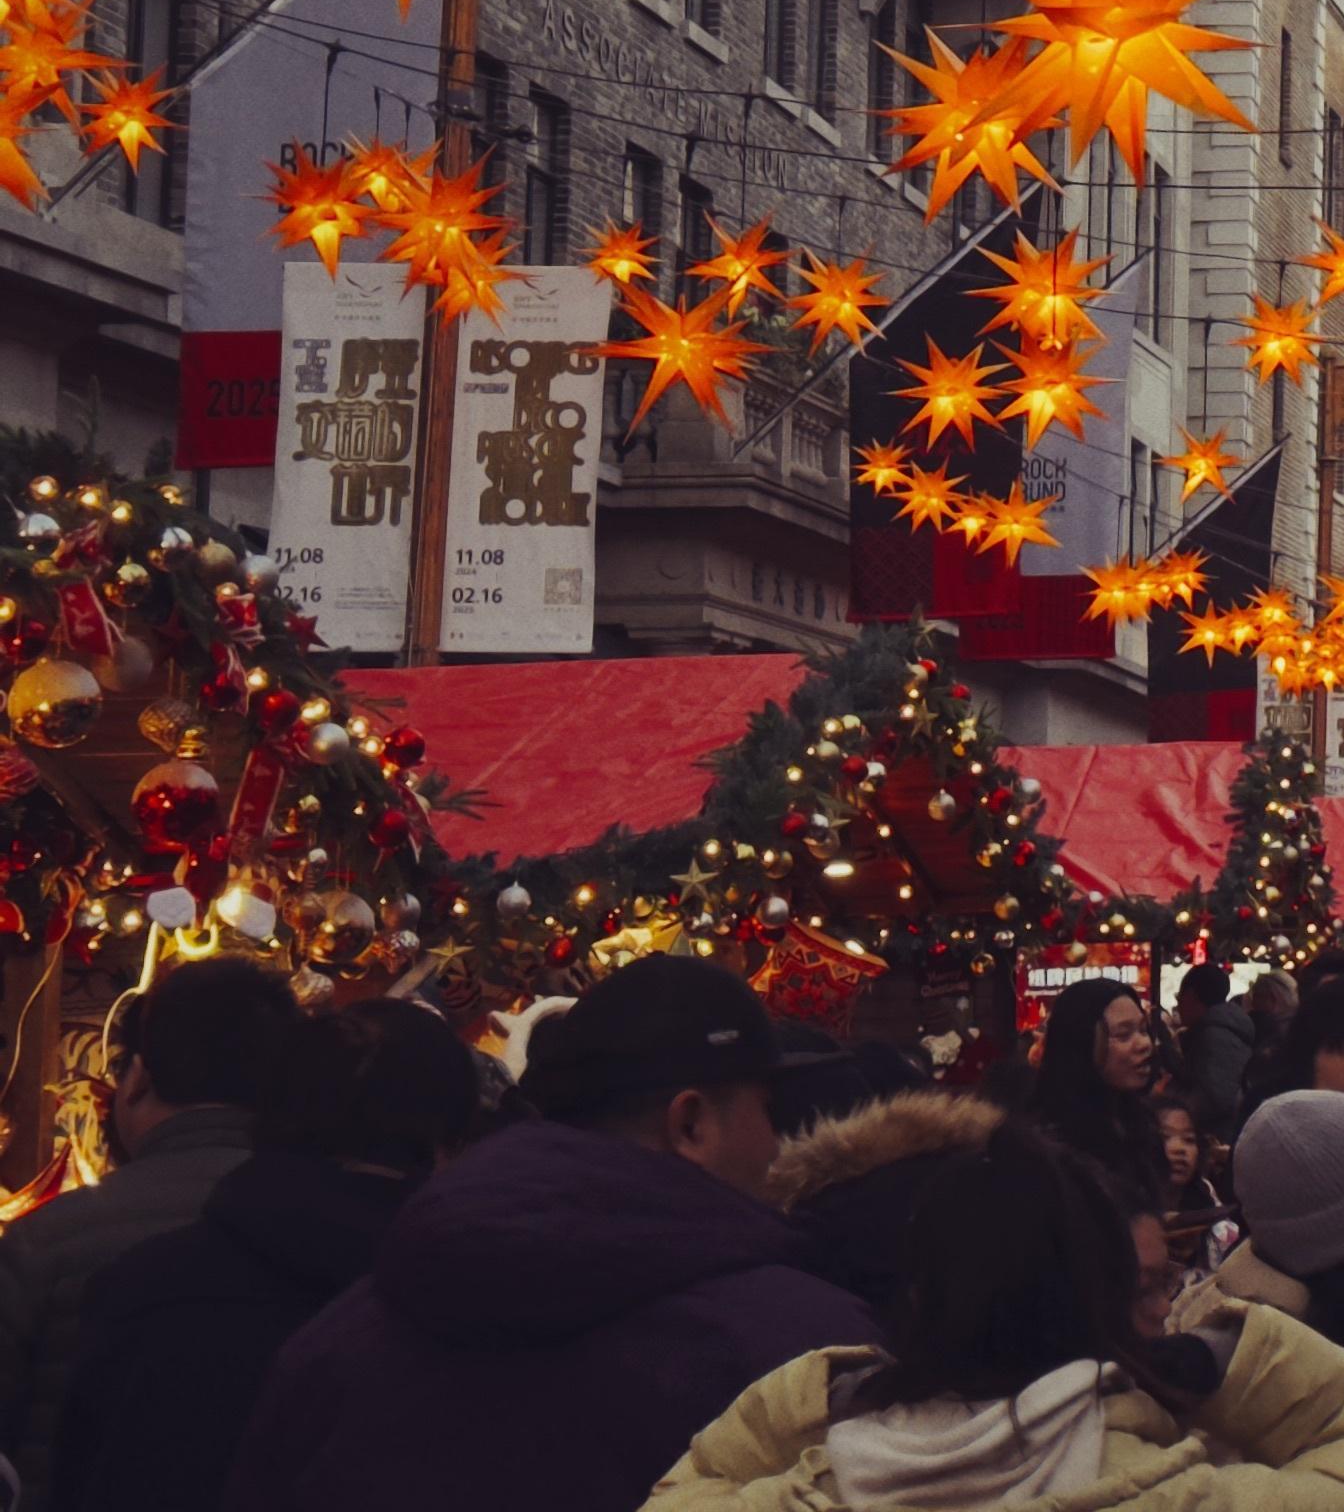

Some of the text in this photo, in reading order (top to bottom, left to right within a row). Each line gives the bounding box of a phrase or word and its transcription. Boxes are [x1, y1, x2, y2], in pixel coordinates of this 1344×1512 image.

[274, 547, 324, 564] 11.08
[456, 549, 505, 566] 11.08
[452, 587, 503, 604] 02.16
